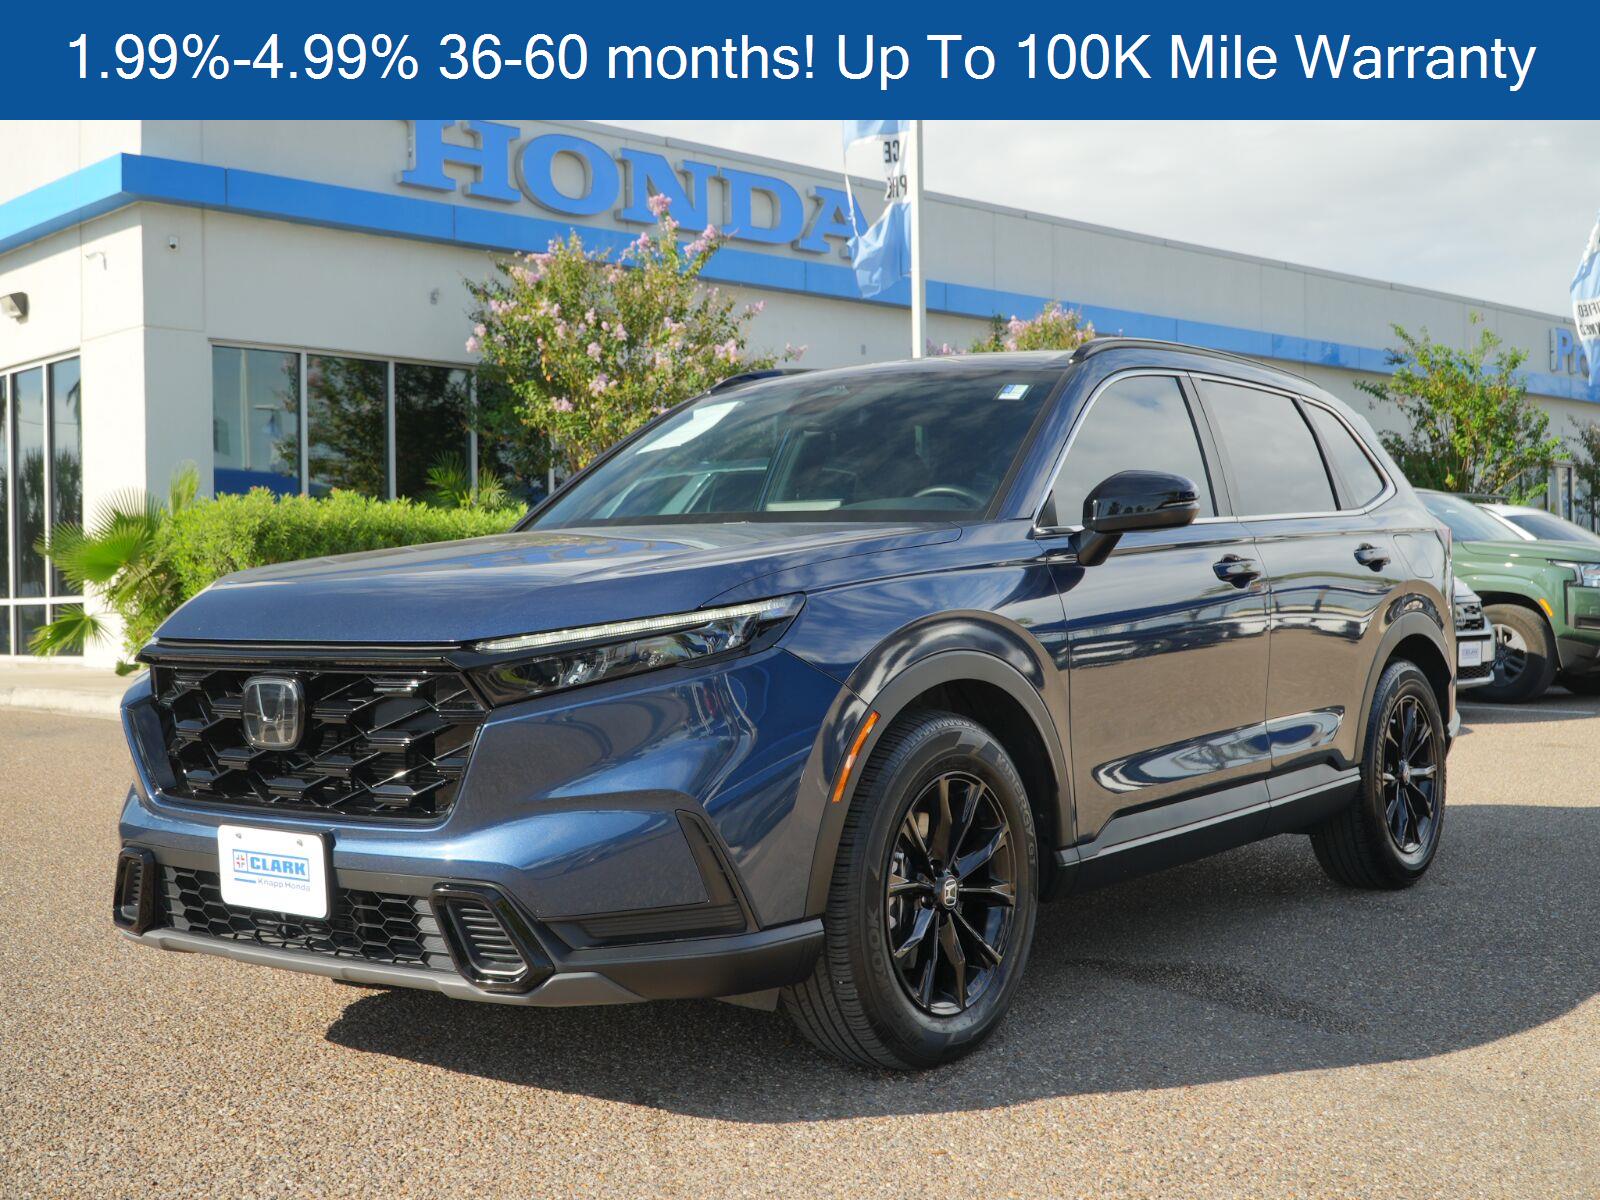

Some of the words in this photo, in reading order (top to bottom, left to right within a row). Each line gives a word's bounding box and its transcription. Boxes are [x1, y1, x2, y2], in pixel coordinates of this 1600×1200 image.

[399, 119, 868, 259] HONDA
[249, 856, 306, 876] CLARK
[257, 877, 284, 889] Knapp
[284, 882, 311, 893] Honda
